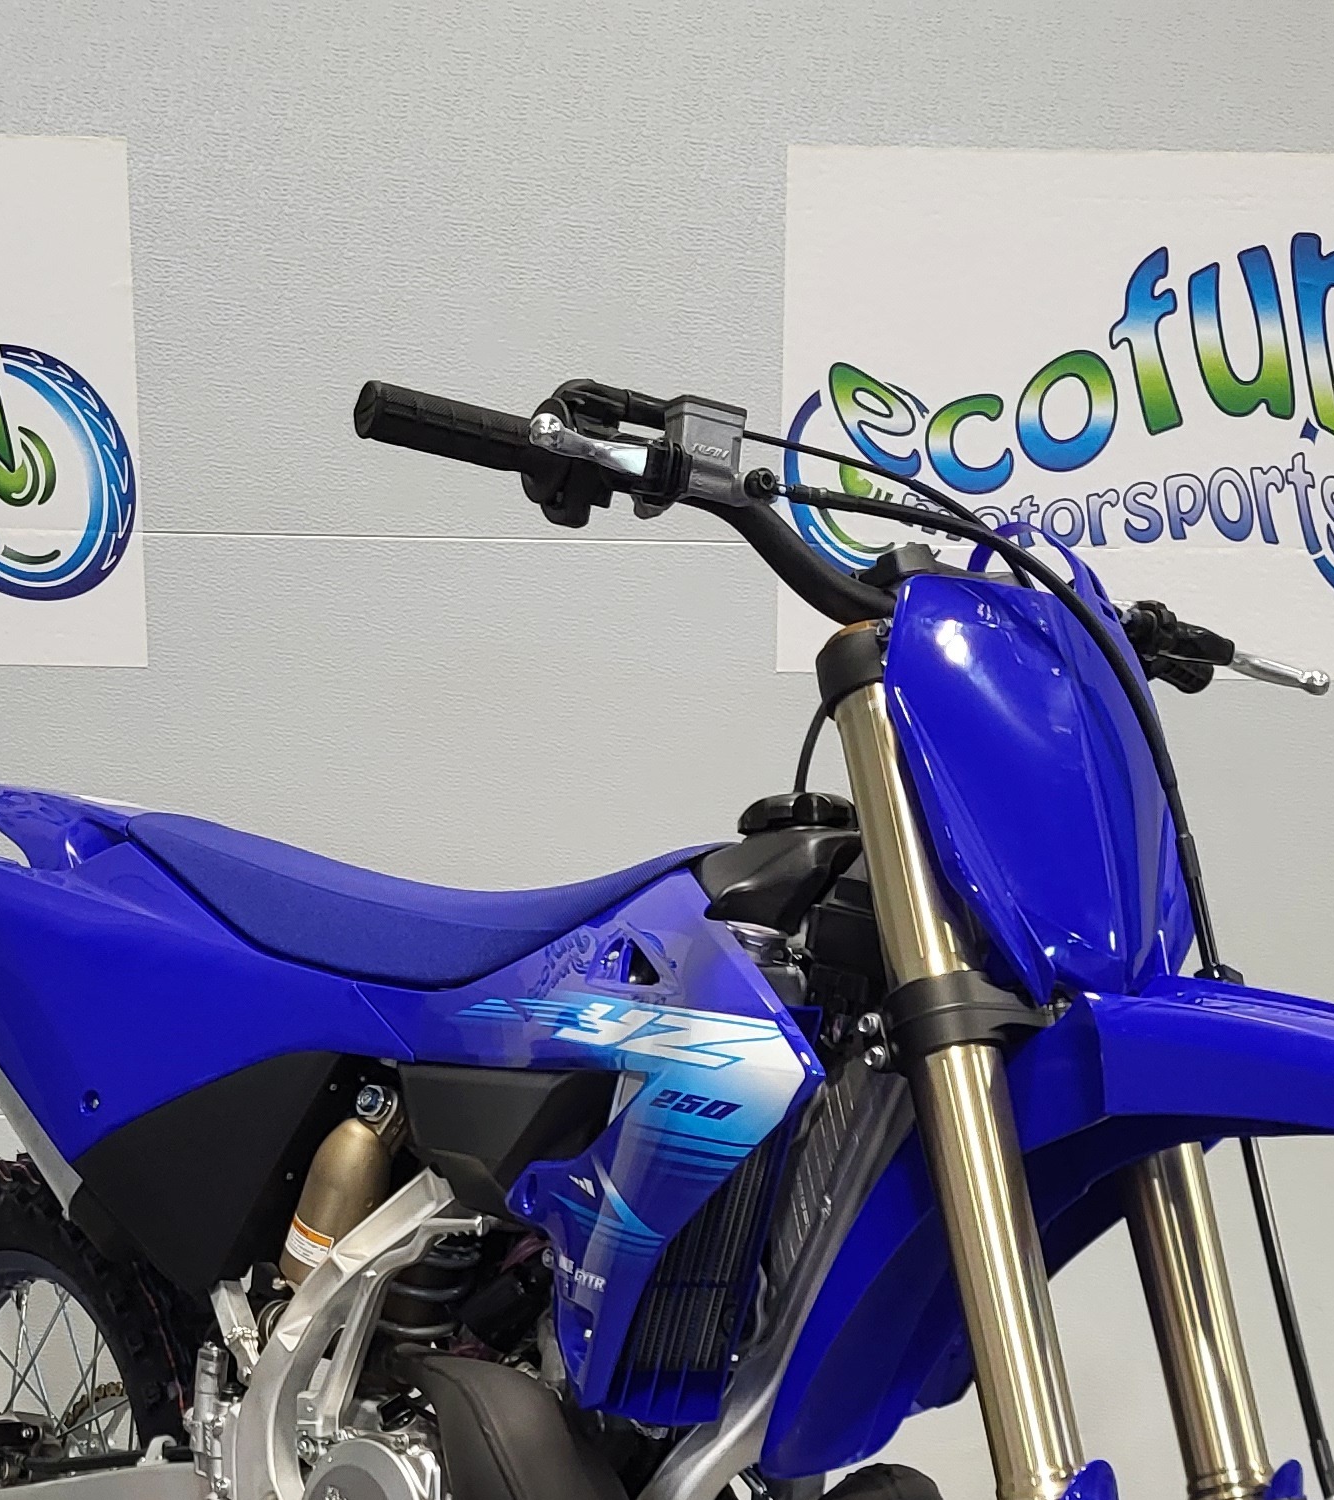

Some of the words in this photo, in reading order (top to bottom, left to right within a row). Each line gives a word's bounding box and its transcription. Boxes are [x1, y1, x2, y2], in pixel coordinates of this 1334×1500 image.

[552, 1002, 782, 1070] YZ
[650, 1089, 743, 1121] 250
[574, 1268, 606, 1293] GYTR
